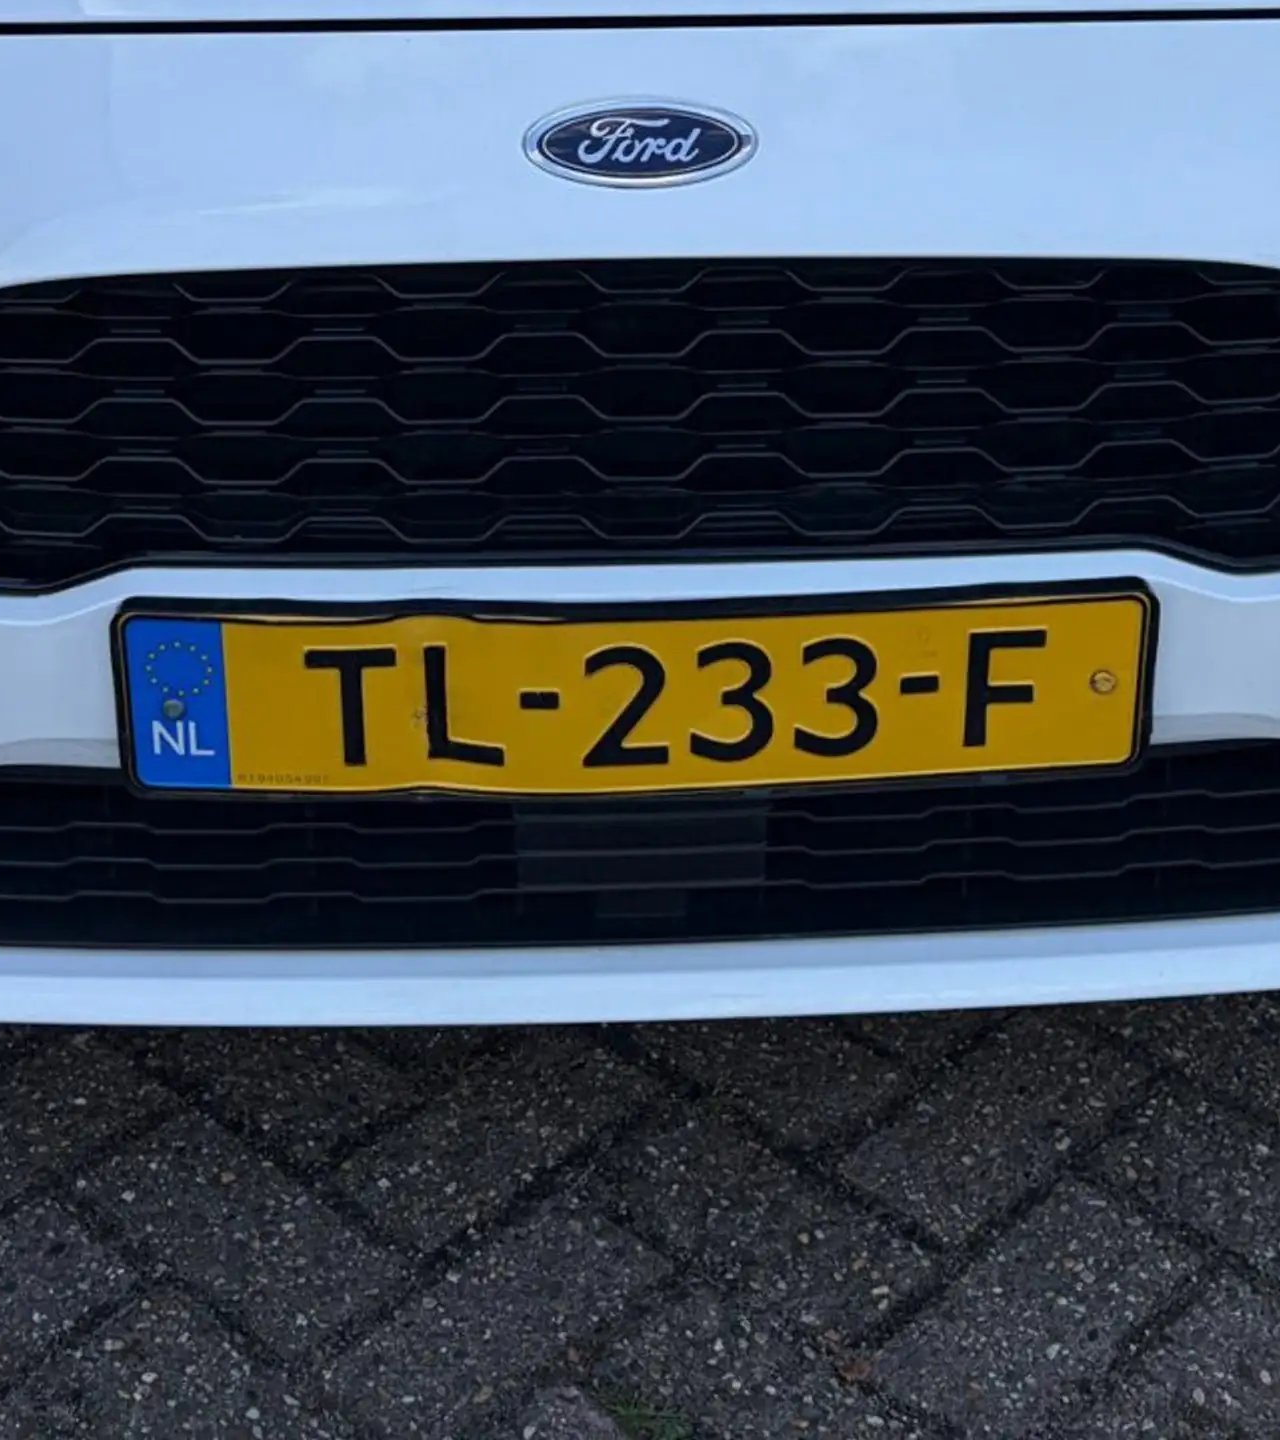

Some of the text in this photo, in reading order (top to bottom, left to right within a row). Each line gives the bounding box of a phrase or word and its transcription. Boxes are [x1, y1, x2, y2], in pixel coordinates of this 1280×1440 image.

[577, 117, 701, 164] Ford
[305, 628, 1047, 766] TL-233-F
[151, 719, 215, 758] NL
